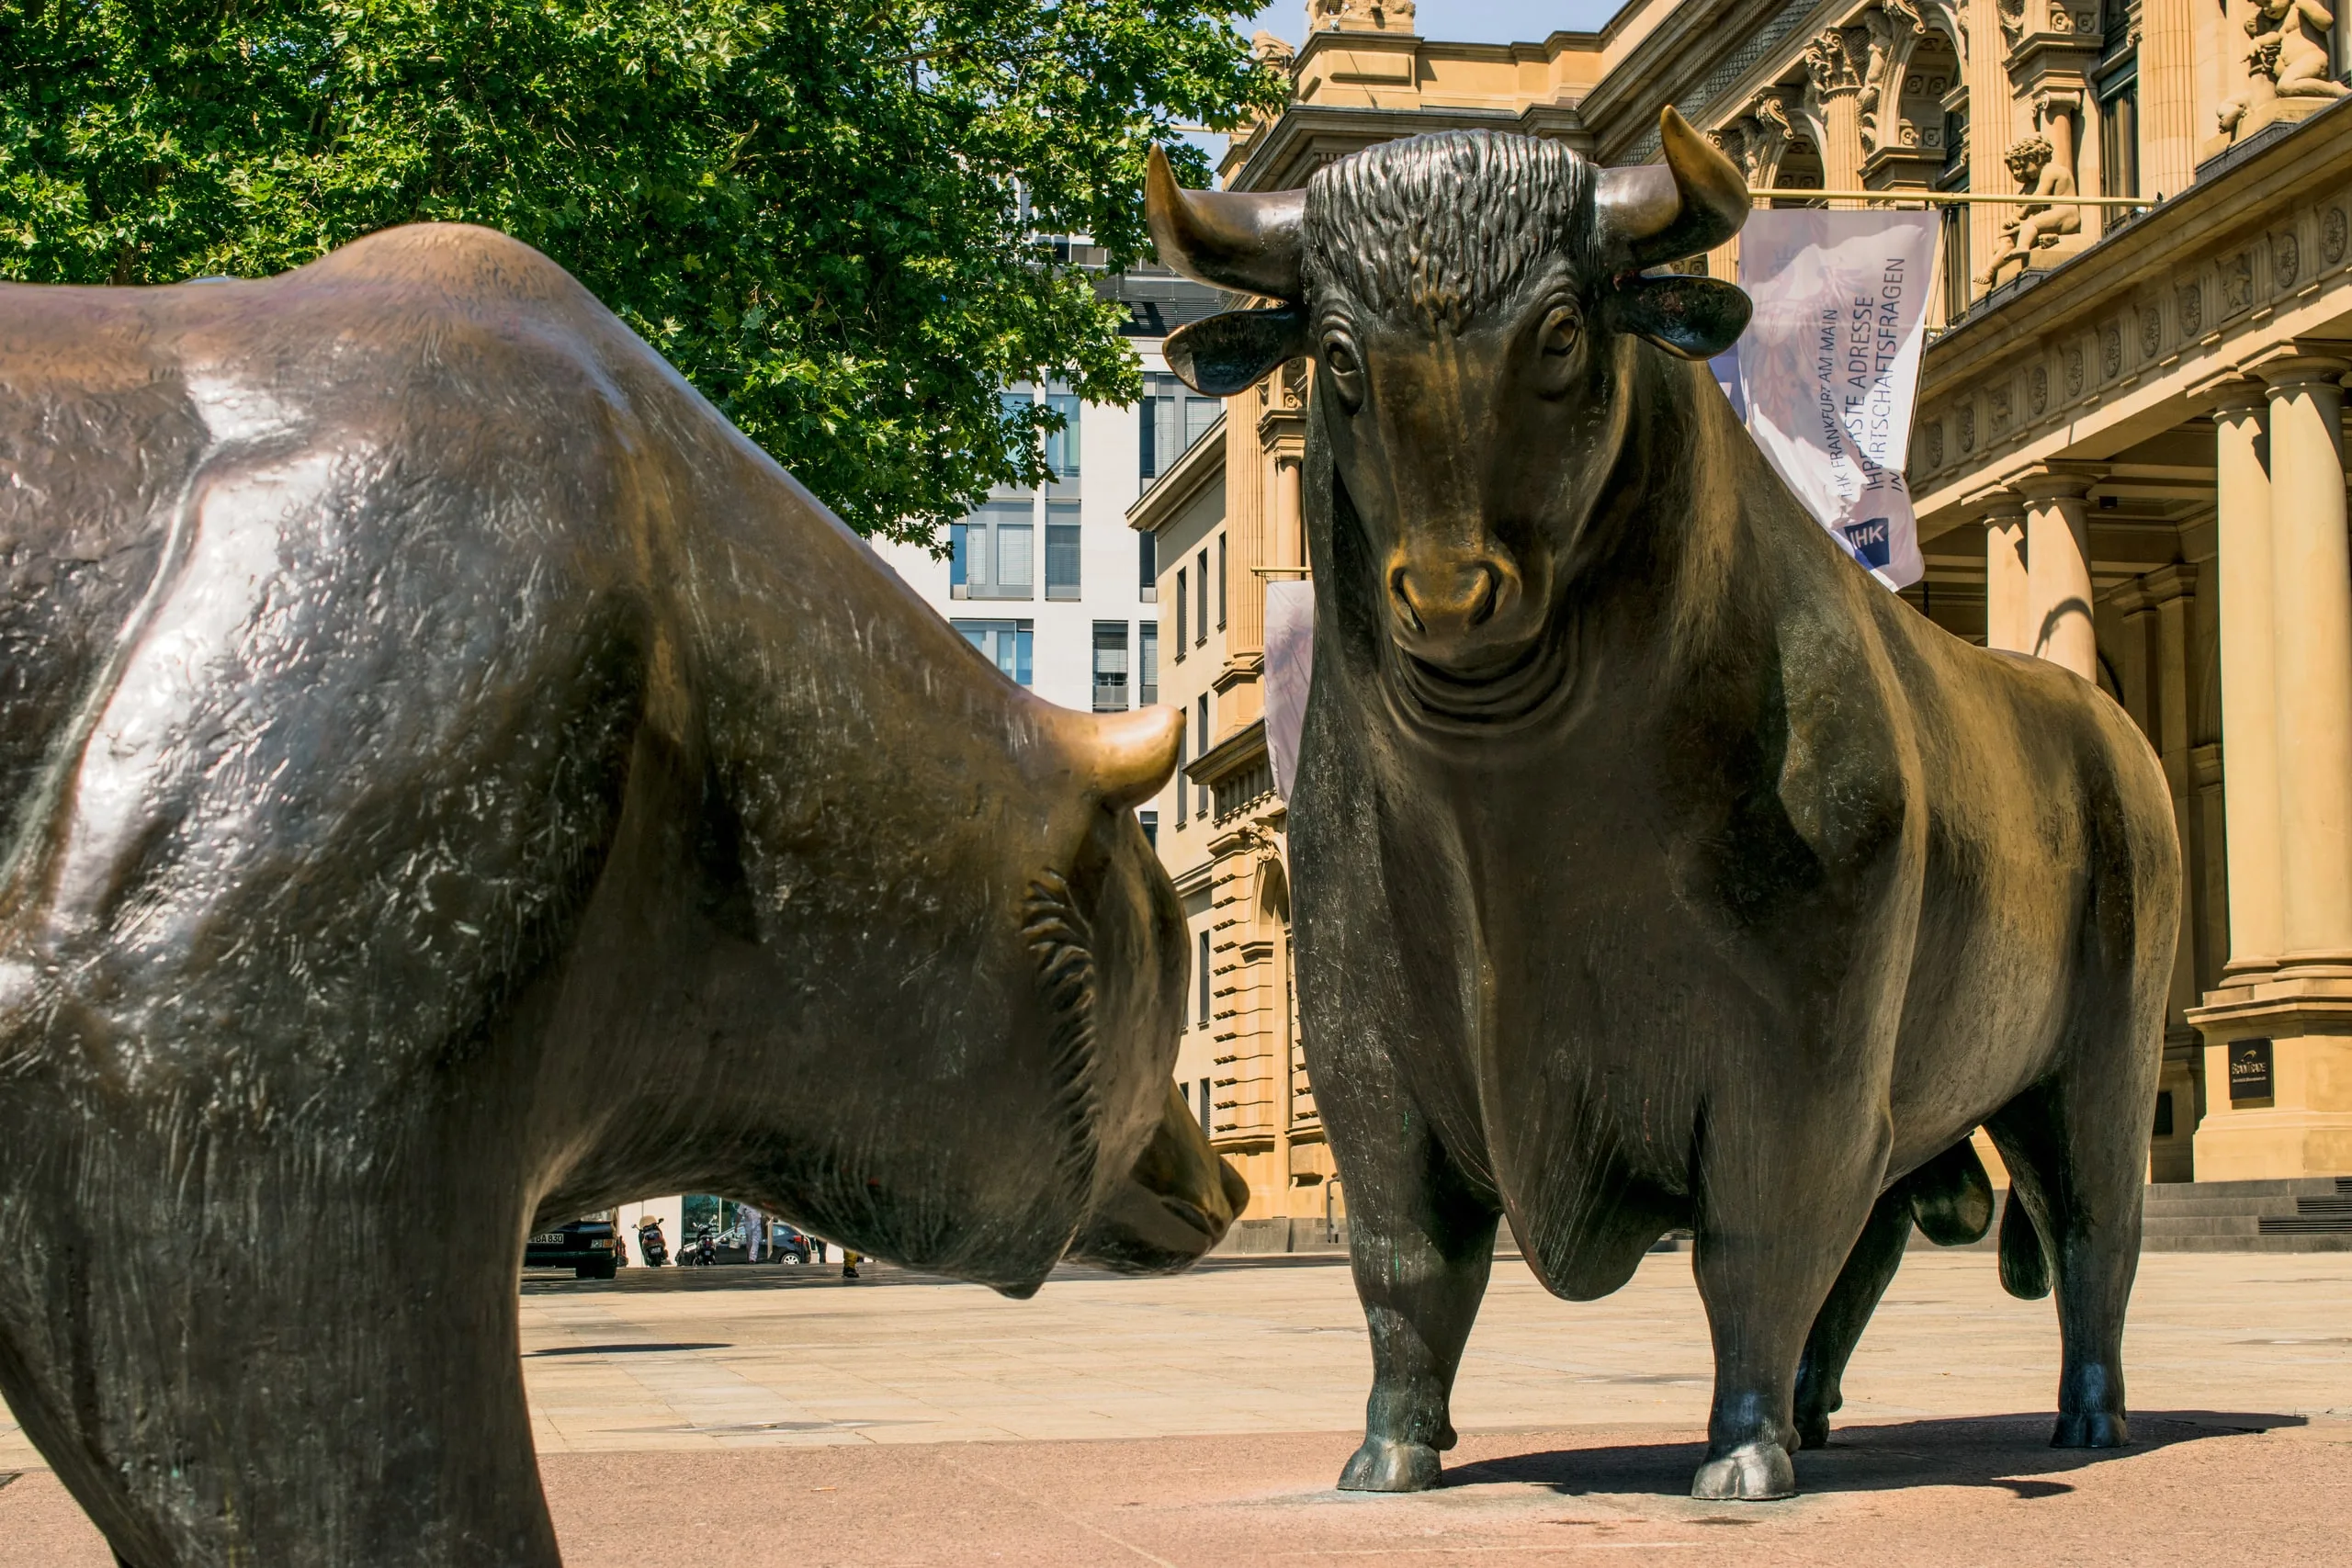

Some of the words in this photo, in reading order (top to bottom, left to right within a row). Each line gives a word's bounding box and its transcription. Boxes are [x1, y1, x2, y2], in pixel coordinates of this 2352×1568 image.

[1820, 310, 1838, 350] MAIN
[1848, 297, 1874, 389] ADRESSE
[1818, 357, 1833, 382] AM
[1869, 258, 1905, 459] IRTSCHAFTSFRAGEN
[1819, 383, 1845, 468] FRANKFURT
[1844, 395, 1865, 444] STE
[1834, 472, 1852, 497] IHK
[1889, 471, 1904, 492] IN
[1849, 525, 1885, 550] IHK
[548, 1235, 563, 1243] 830
